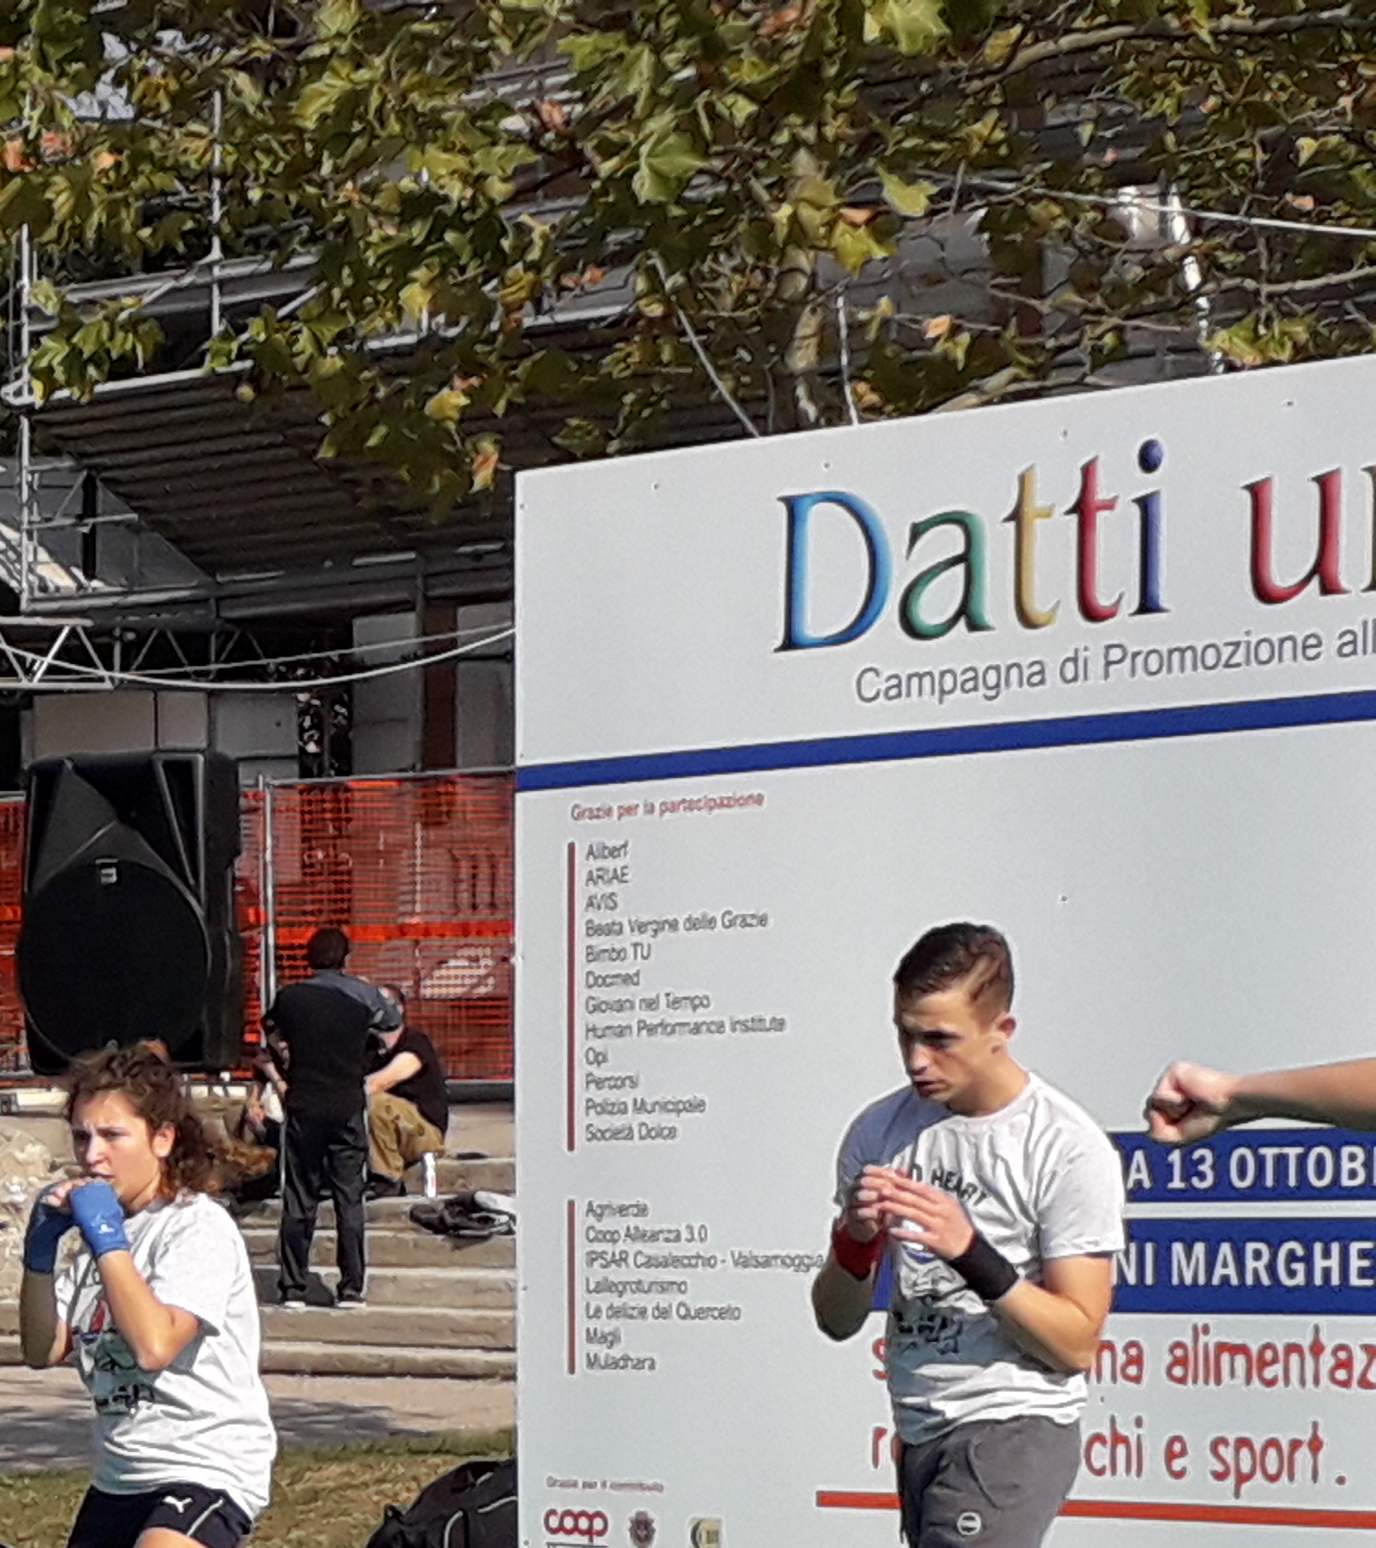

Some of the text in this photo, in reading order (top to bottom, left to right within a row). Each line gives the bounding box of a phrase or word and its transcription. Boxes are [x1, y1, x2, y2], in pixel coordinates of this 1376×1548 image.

[773, 439, 1376, 653] Datti u
[856, 656, 1047, 704] Campagna
[1059, 646, 1090, 685] di
[1103, 629, 1323, 681] Promozione
[571, 803, 613, 821] Grazie
[617, 803, 639, 821] per
[659, 792, 764, 817] partecipazione
[584, 892, 618, 911] AVIS
[585, 910, 768, 938] Beata Vergine delle Grazie
[585, 942, 652, 962] Bimbo TU
[638, 993, 660, 1011] nel
[664, 991, 711, 1012] Tempo
[585, 1015, 786, 1040] Human Performance Institute
[585, 1096, 707, 1116] Polizia Municipale
[1126, 1145, 1376, 1190] A 13 OTTOB
[930, 1168, 987, 1206] HEART
[585, 1224, 708, 1244] Coop Alleanza 3.0
[633, 1250, 717, 1268] Casalecchio
[730, 1250, 824, 1272] Valsamoggia
[1171, 1240, 1375, 1287] MARGHE
[585, 1302, 741, 1320] Le delizie del Querceto
[1085, 1340, 1144, 1385] na
[1165, 1323, 1376, 1390] alimentaz
[1084, 1413, 1144, 1479] chi
[1165, 1435, 1189, 1479] e
[1209, 1420, 1347, 1499] sport.
[544, 1508, 608, 1543] coop
